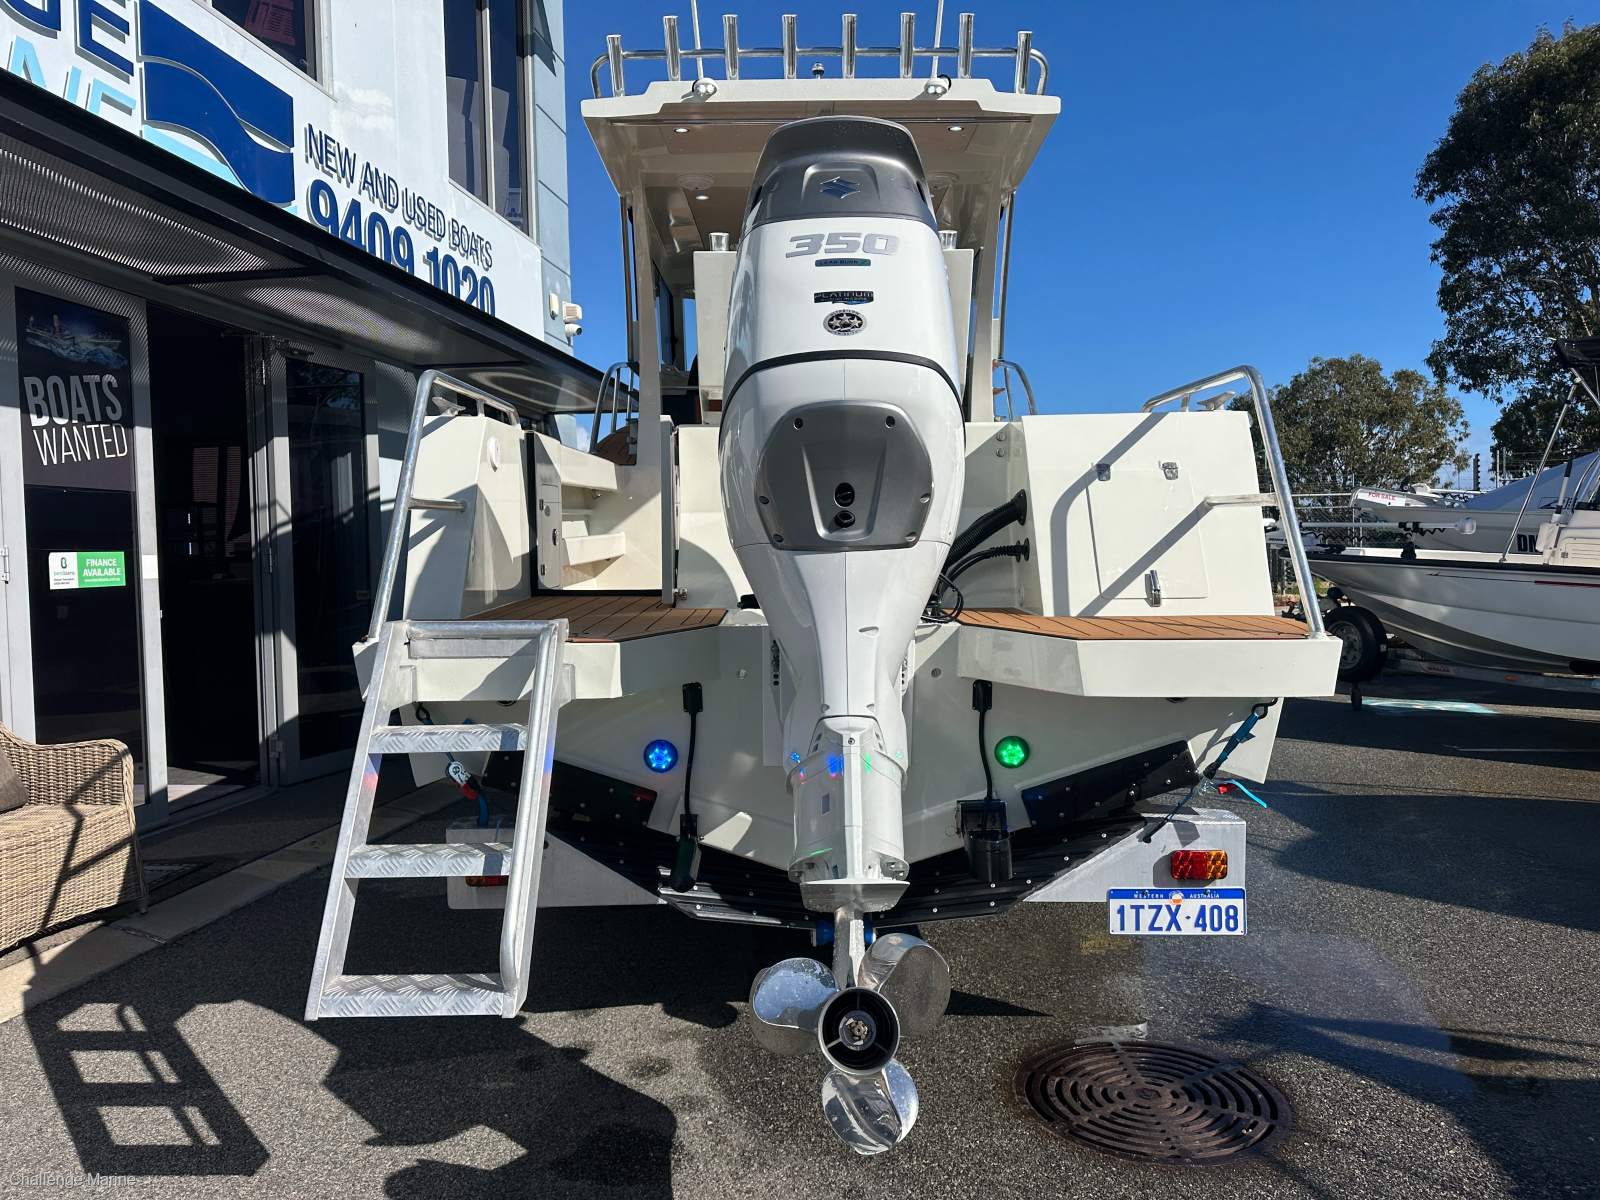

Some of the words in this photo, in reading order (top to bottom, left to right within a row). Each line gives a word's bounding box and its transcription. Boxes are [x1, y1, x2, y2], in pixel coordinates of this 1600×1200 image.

[307, 123, 356, 184] NEW
[362, 161, 399, 210] AND
[405, 187, 446, 239] USED
[451, 218, 493, 268] BOATS
[309, 179, 415, 276] 9409
[785, 232, 898, 258] 350
[24, 374, 122, 426] BOATS
[33, 423, 128, 465] WANTED
[83, 567, 121, 577] AVAILABLE
[86, 558, 117, 567] FINANCE
